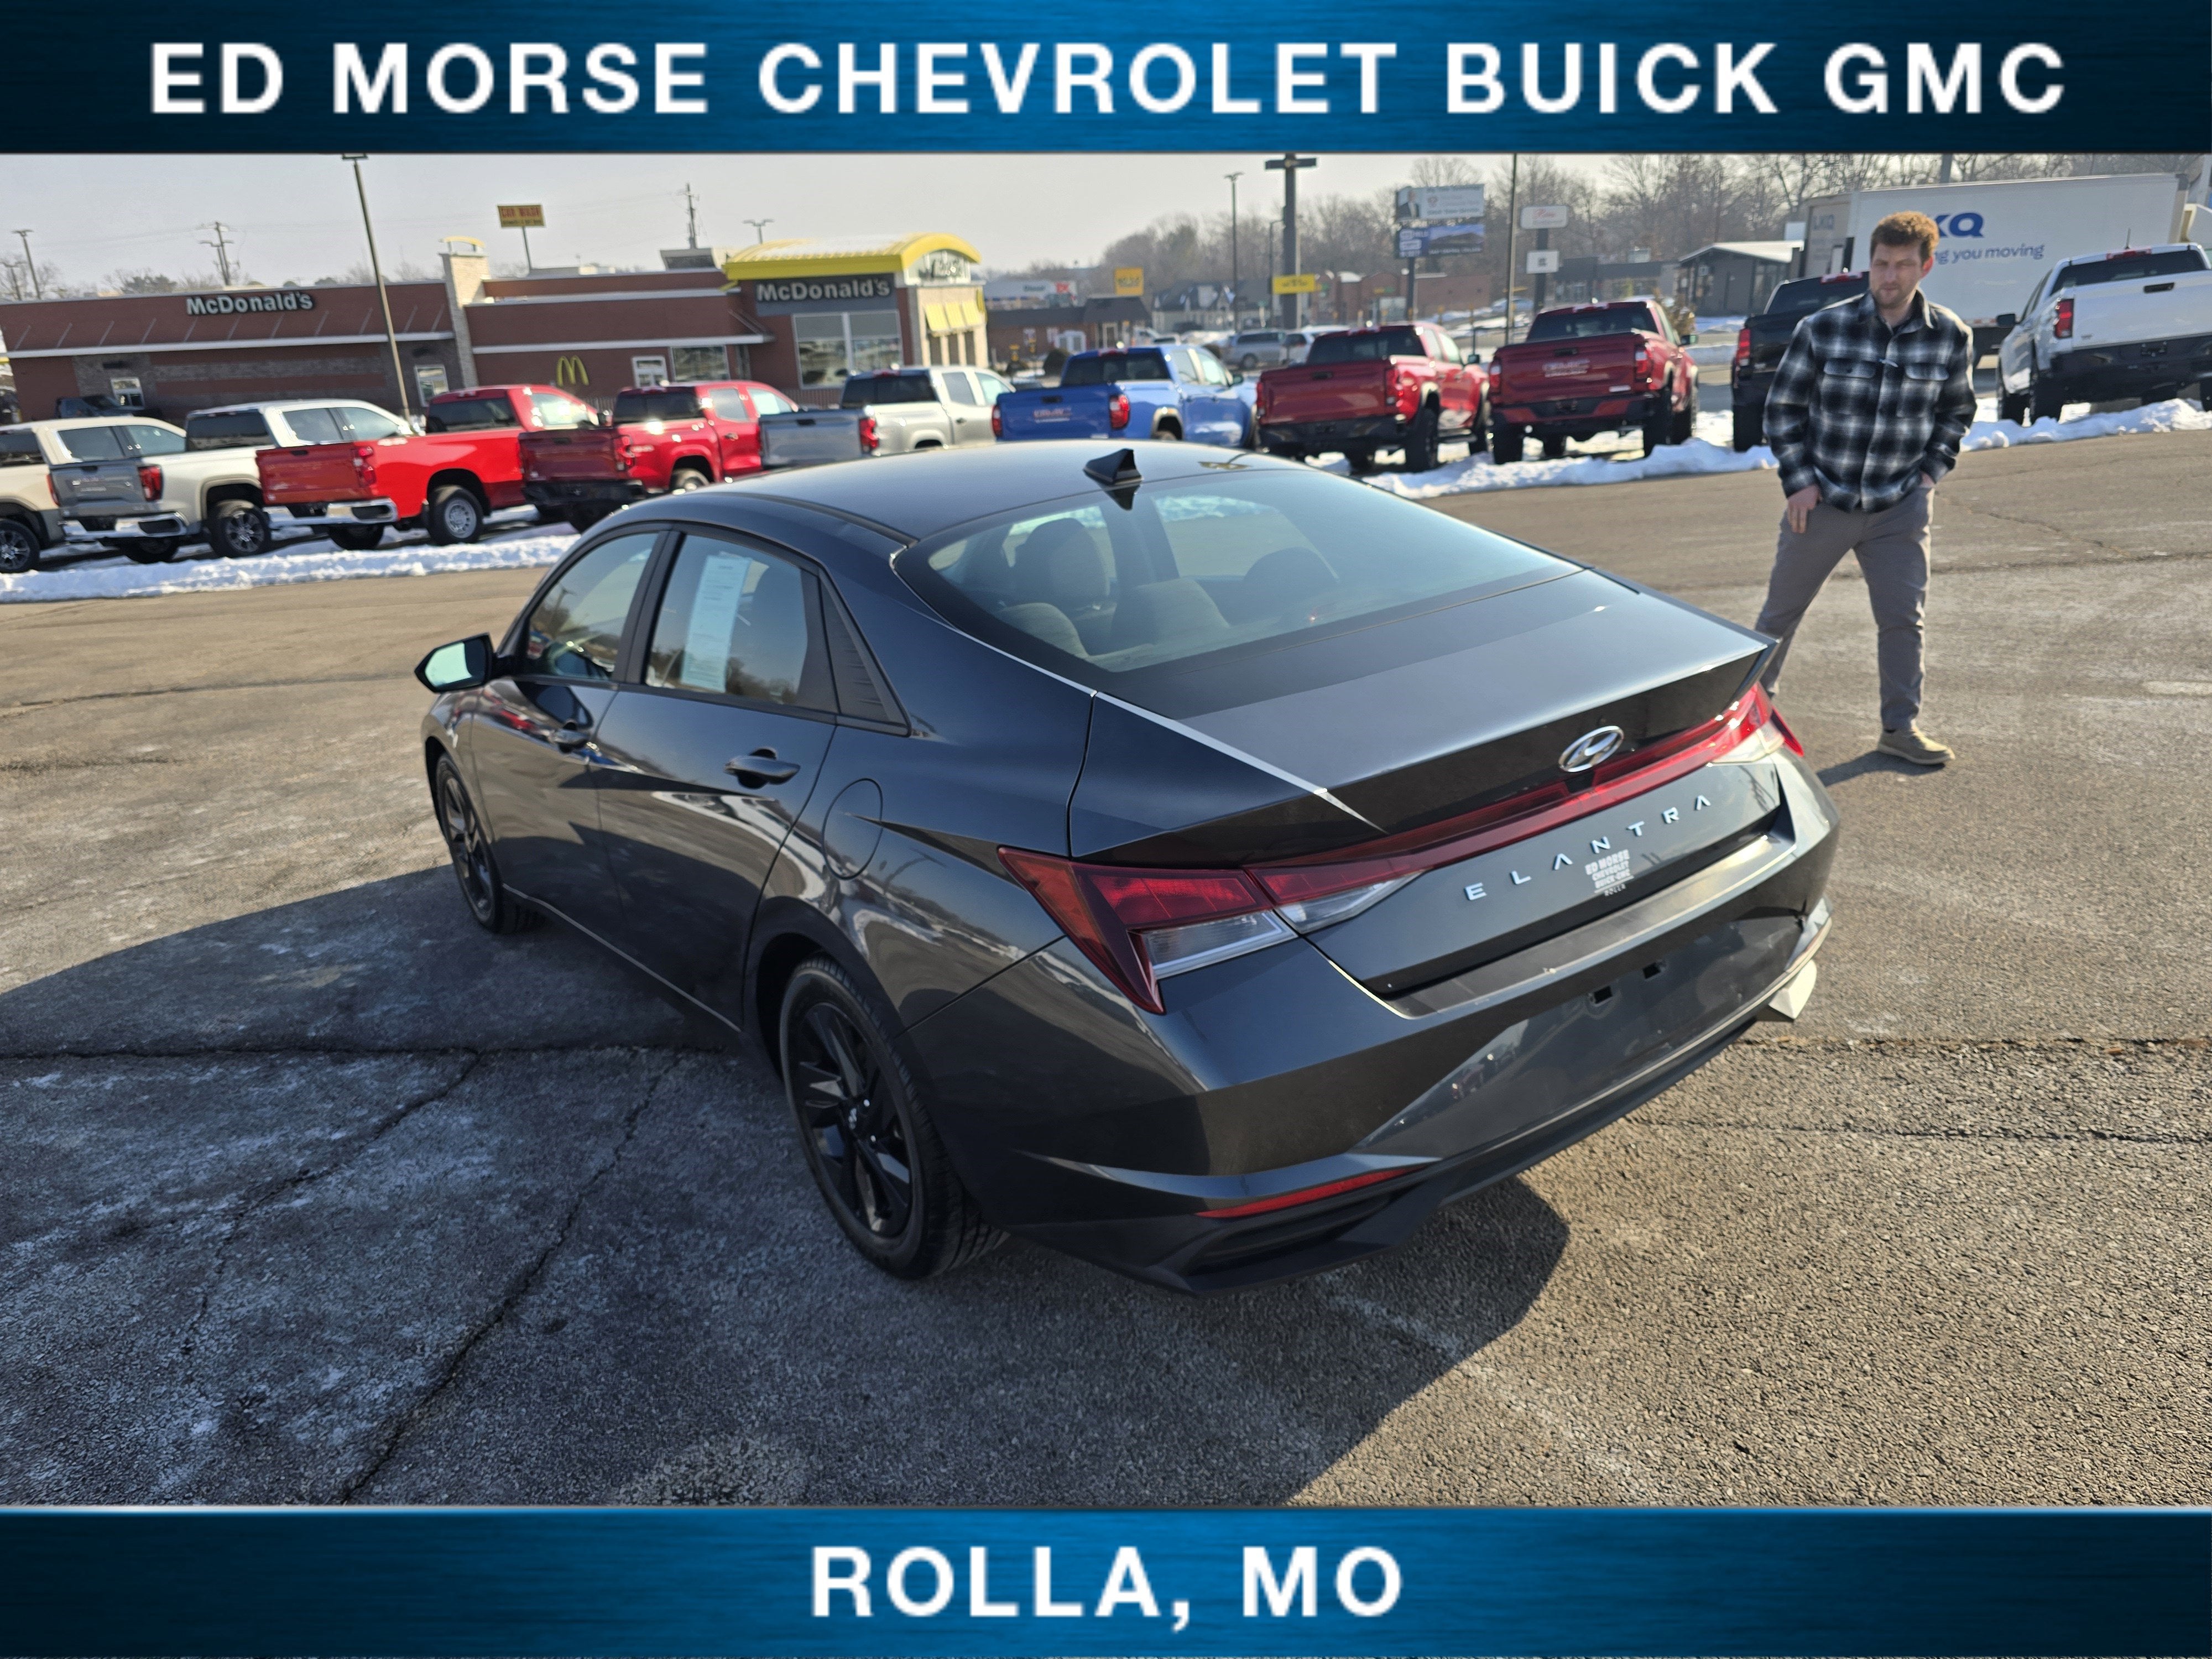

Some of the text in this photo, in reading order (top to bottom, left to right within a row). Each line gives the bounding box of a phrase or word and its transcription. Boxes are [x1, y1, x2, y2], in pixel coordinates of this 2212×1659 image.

[1952, 249, 1983, 264] you
[1984, 243, 2045, 260] moving
[757, 279, 890, 301] McDonald's
[186, 291, 313, 315] McDonald's
[1464, 795, 1711, 901] ELANTRA
[1585, 849, 1630, 875] ED MORSE
[1604, 884, 1626, 896] ROLLA
